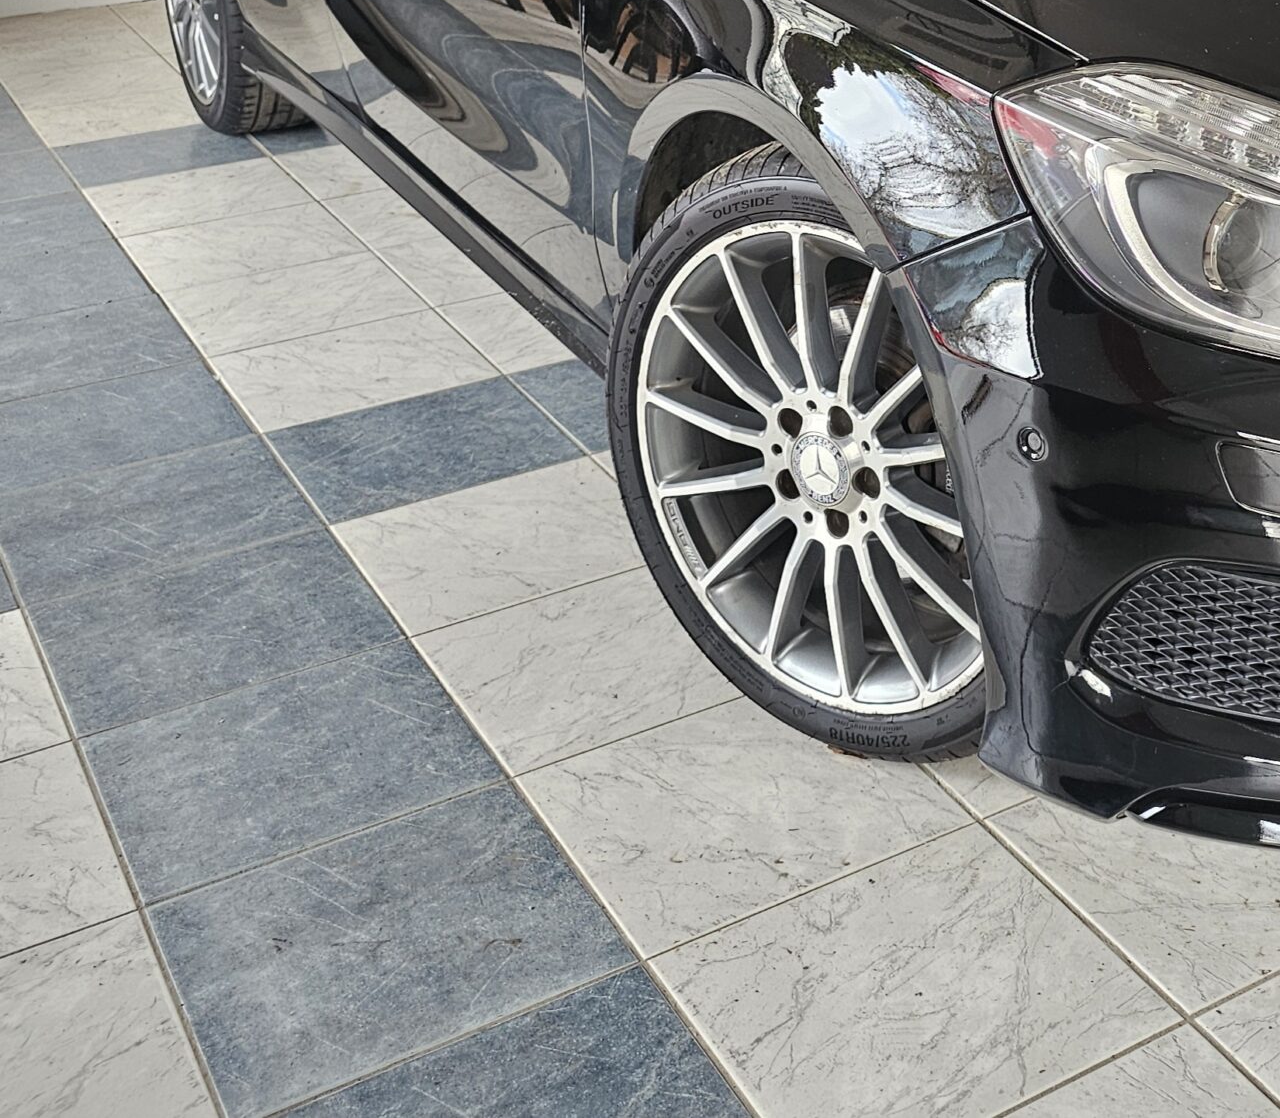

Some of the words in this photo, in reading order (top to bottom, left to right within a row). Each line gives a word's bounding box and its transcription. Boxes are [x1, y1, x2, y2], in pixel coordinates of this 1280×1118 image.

[712, 196, 775, 220] OUTSIDE
[799, 436, 839, 456] MERCEDES
[812, 492, 834, 503] BENZ
[829, 727, 910, 748] 225/40R18
